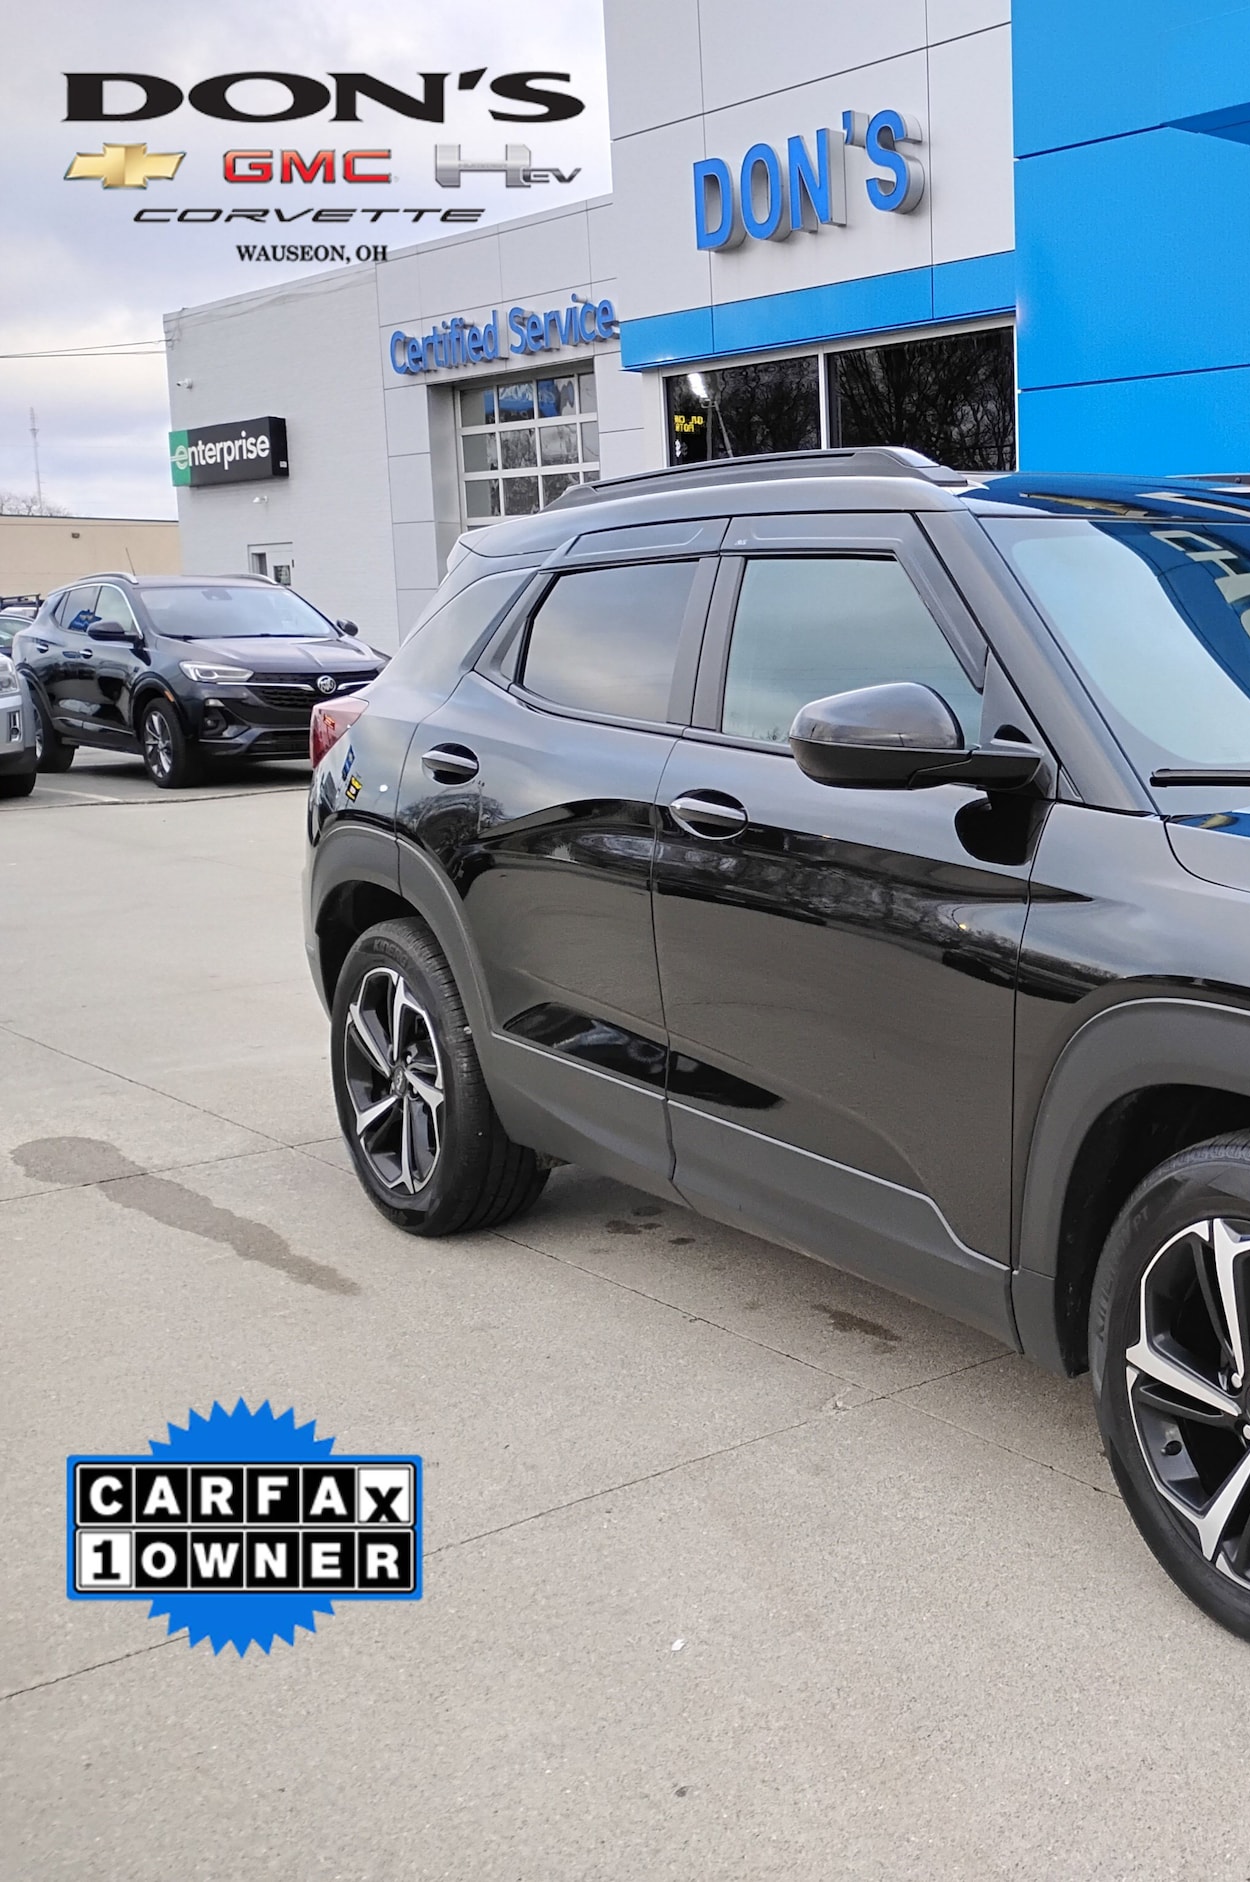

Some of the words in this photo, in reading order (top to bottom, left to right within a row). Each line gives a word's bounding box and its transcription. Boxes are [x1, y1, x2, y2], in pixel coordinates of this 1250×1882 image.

[693, 109, 924, 252] DON'S
[390, 309, 502, 376] Certified
[508, 293, 619, 354] Service
[172, 430, 270, 470] enterprise
